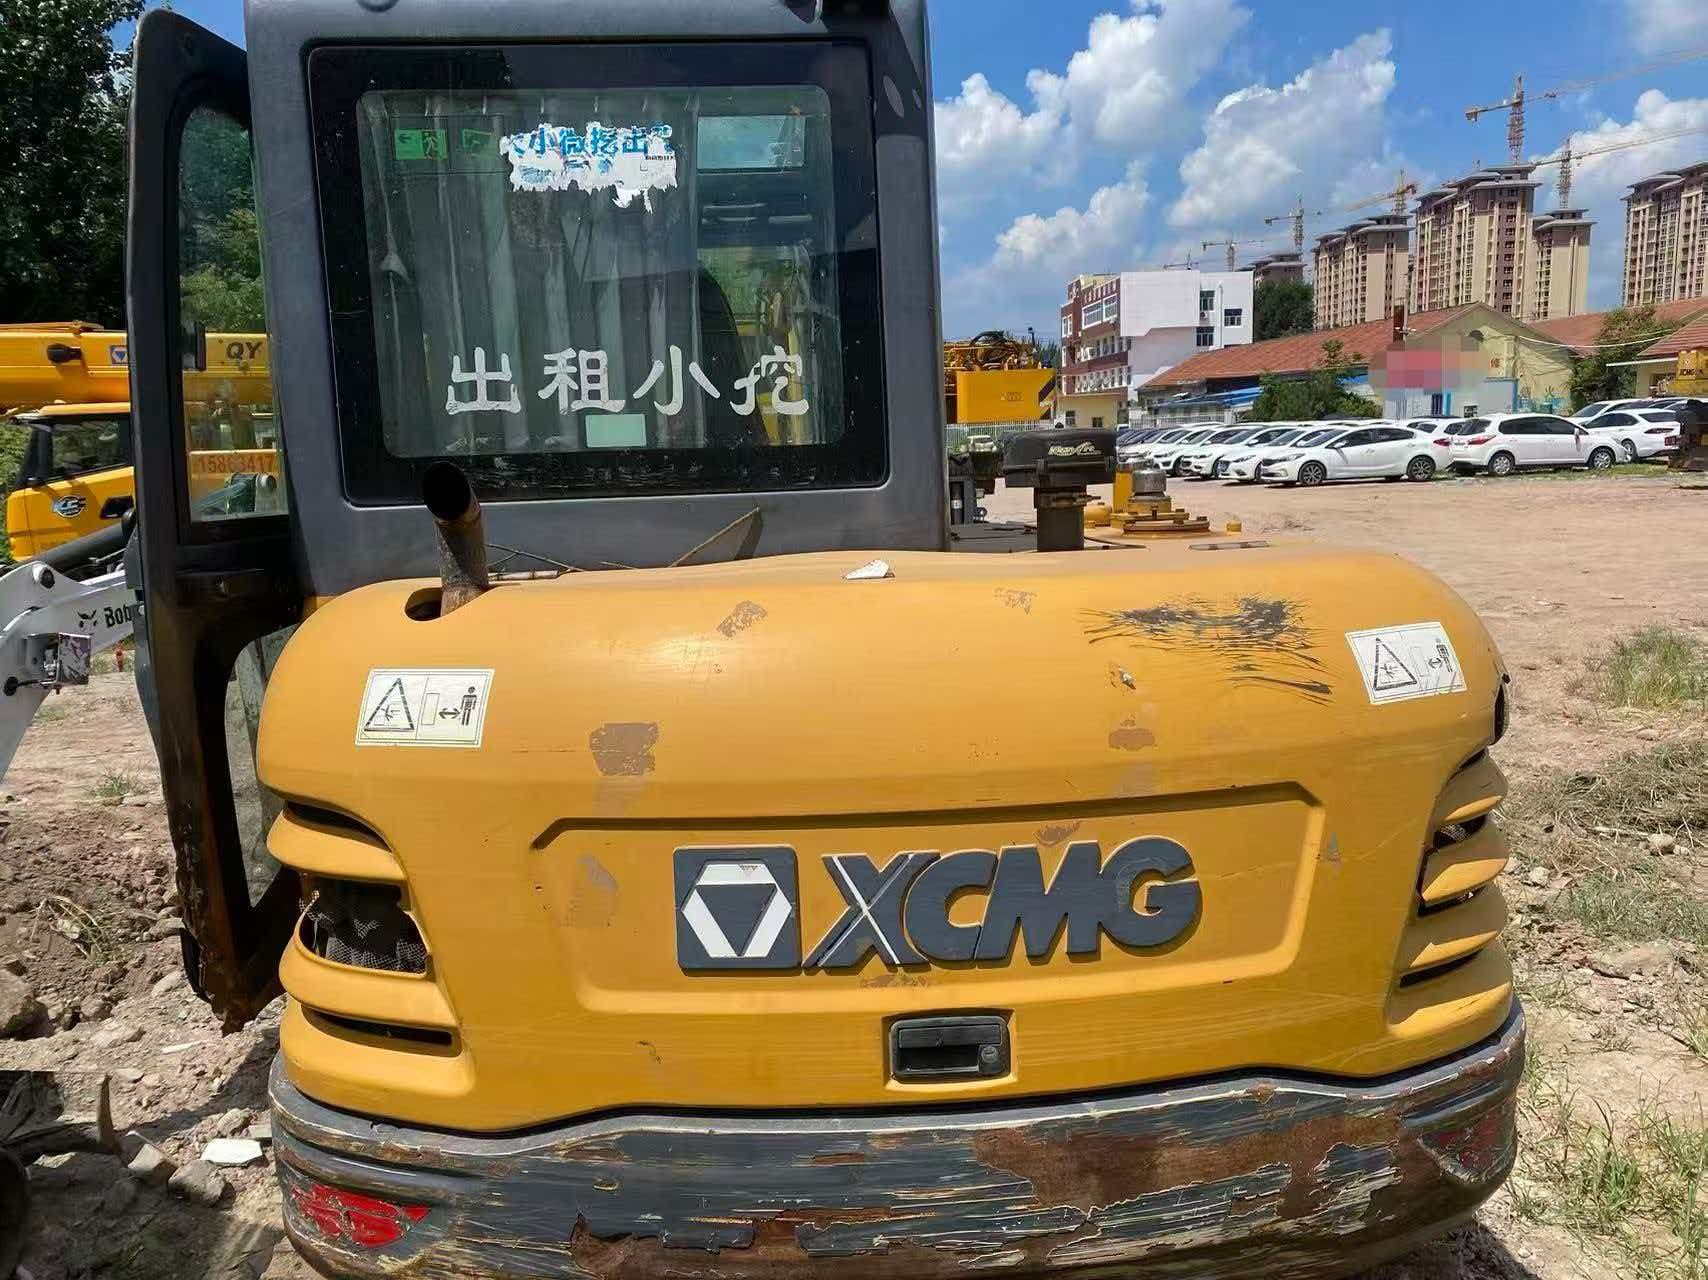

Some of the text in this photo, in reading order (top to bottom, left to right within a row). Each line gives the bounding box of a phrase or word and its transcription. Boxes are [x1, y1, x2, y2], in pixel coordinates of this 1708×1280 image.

[510, 121, 674, 158] 小微挖出
[226, 341, 262, 360] QY
[446, 345, 809, 415] 出租小挖
[802, 835, 1202, 973] XCMG
